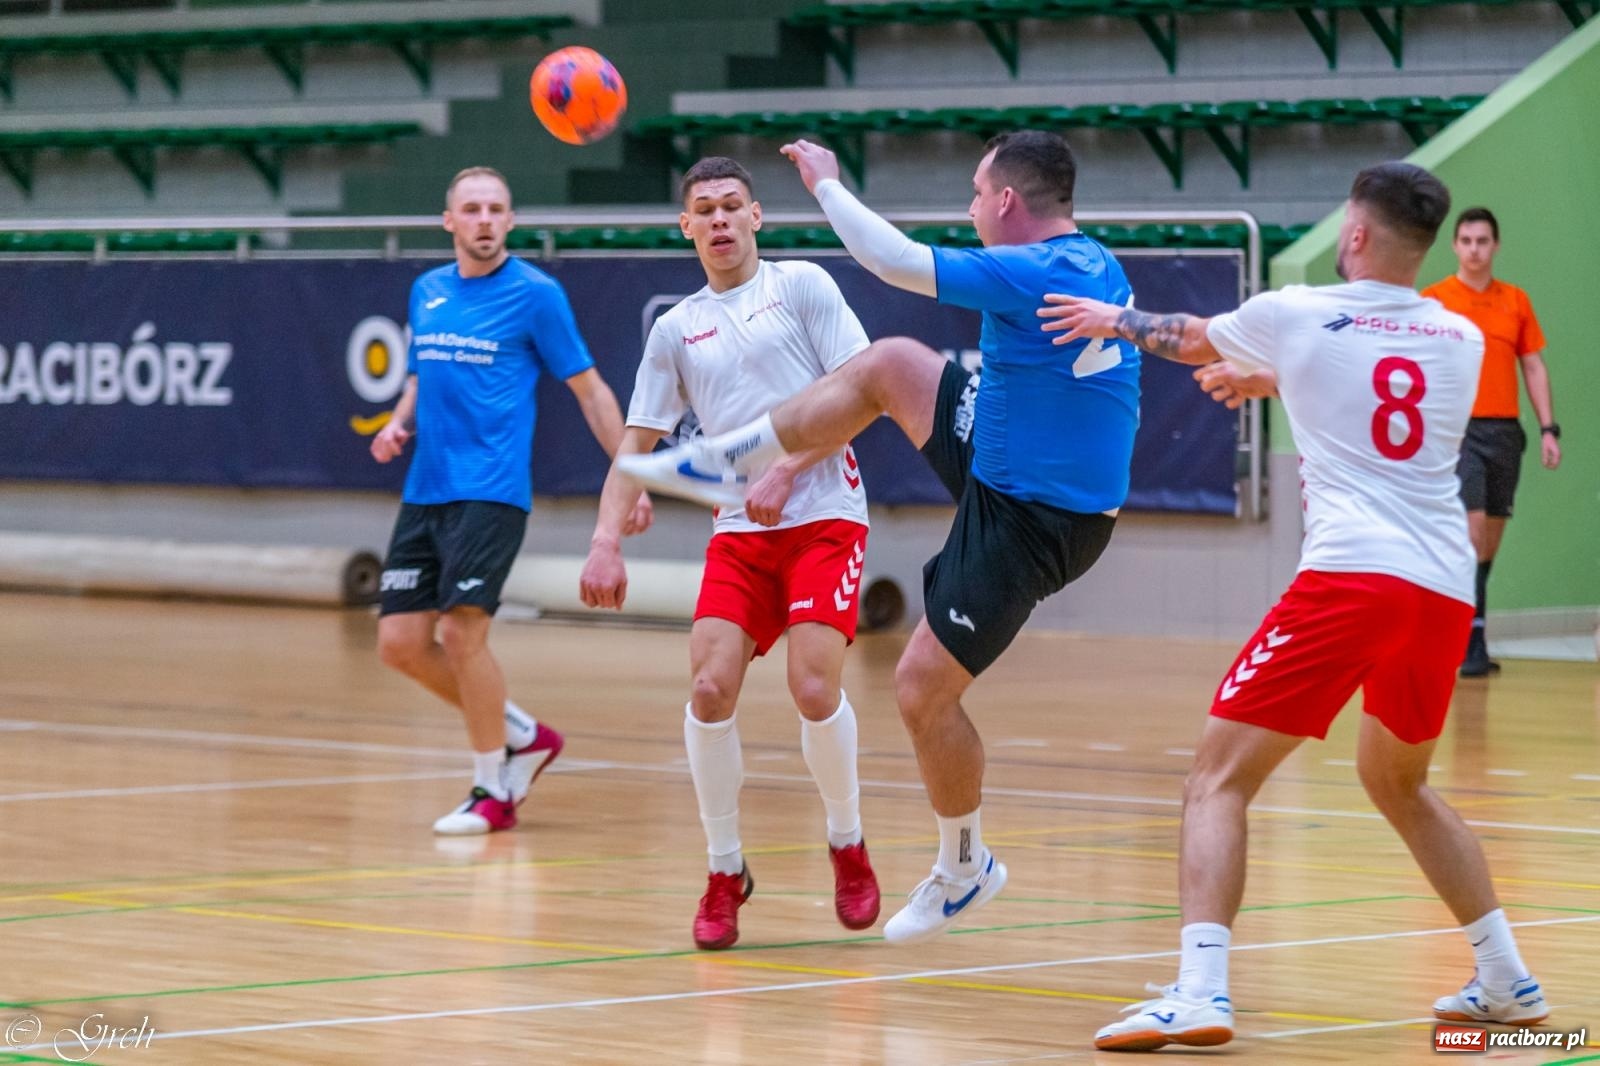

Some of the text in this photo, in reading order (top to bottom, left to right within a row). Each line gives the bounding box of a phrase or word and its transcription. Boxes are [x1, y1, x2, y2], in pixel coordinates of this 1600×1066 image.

[682, 326, 718, 345] hummel
[1371, 356, 1426, 461] 8
[789, 597, 814, 612] mmel
